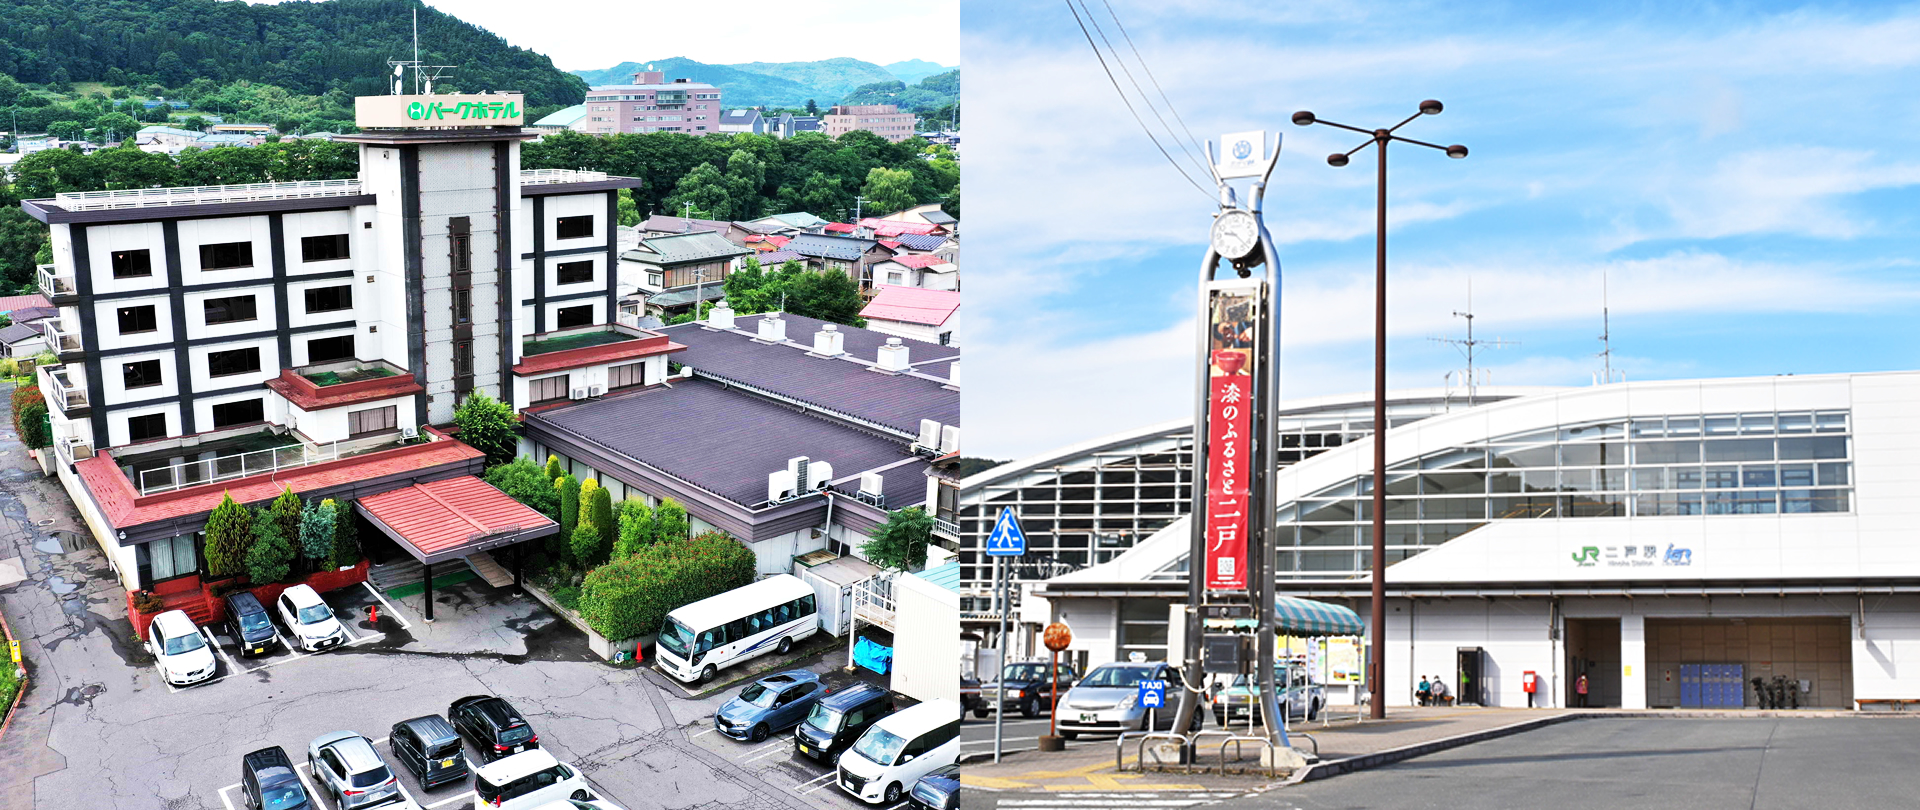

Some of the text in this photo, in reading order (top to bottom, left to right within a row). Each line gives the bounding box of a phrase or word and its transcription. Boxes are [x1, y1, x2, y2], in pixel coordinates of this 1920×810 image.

[424, 101, 520, 119] パークホテル
[1212, 382, 1241, 552] 漆のふるさと二戸
[1572, 546, 1599, 562] JR
[1140, 681, 1162, 689] TAXI
